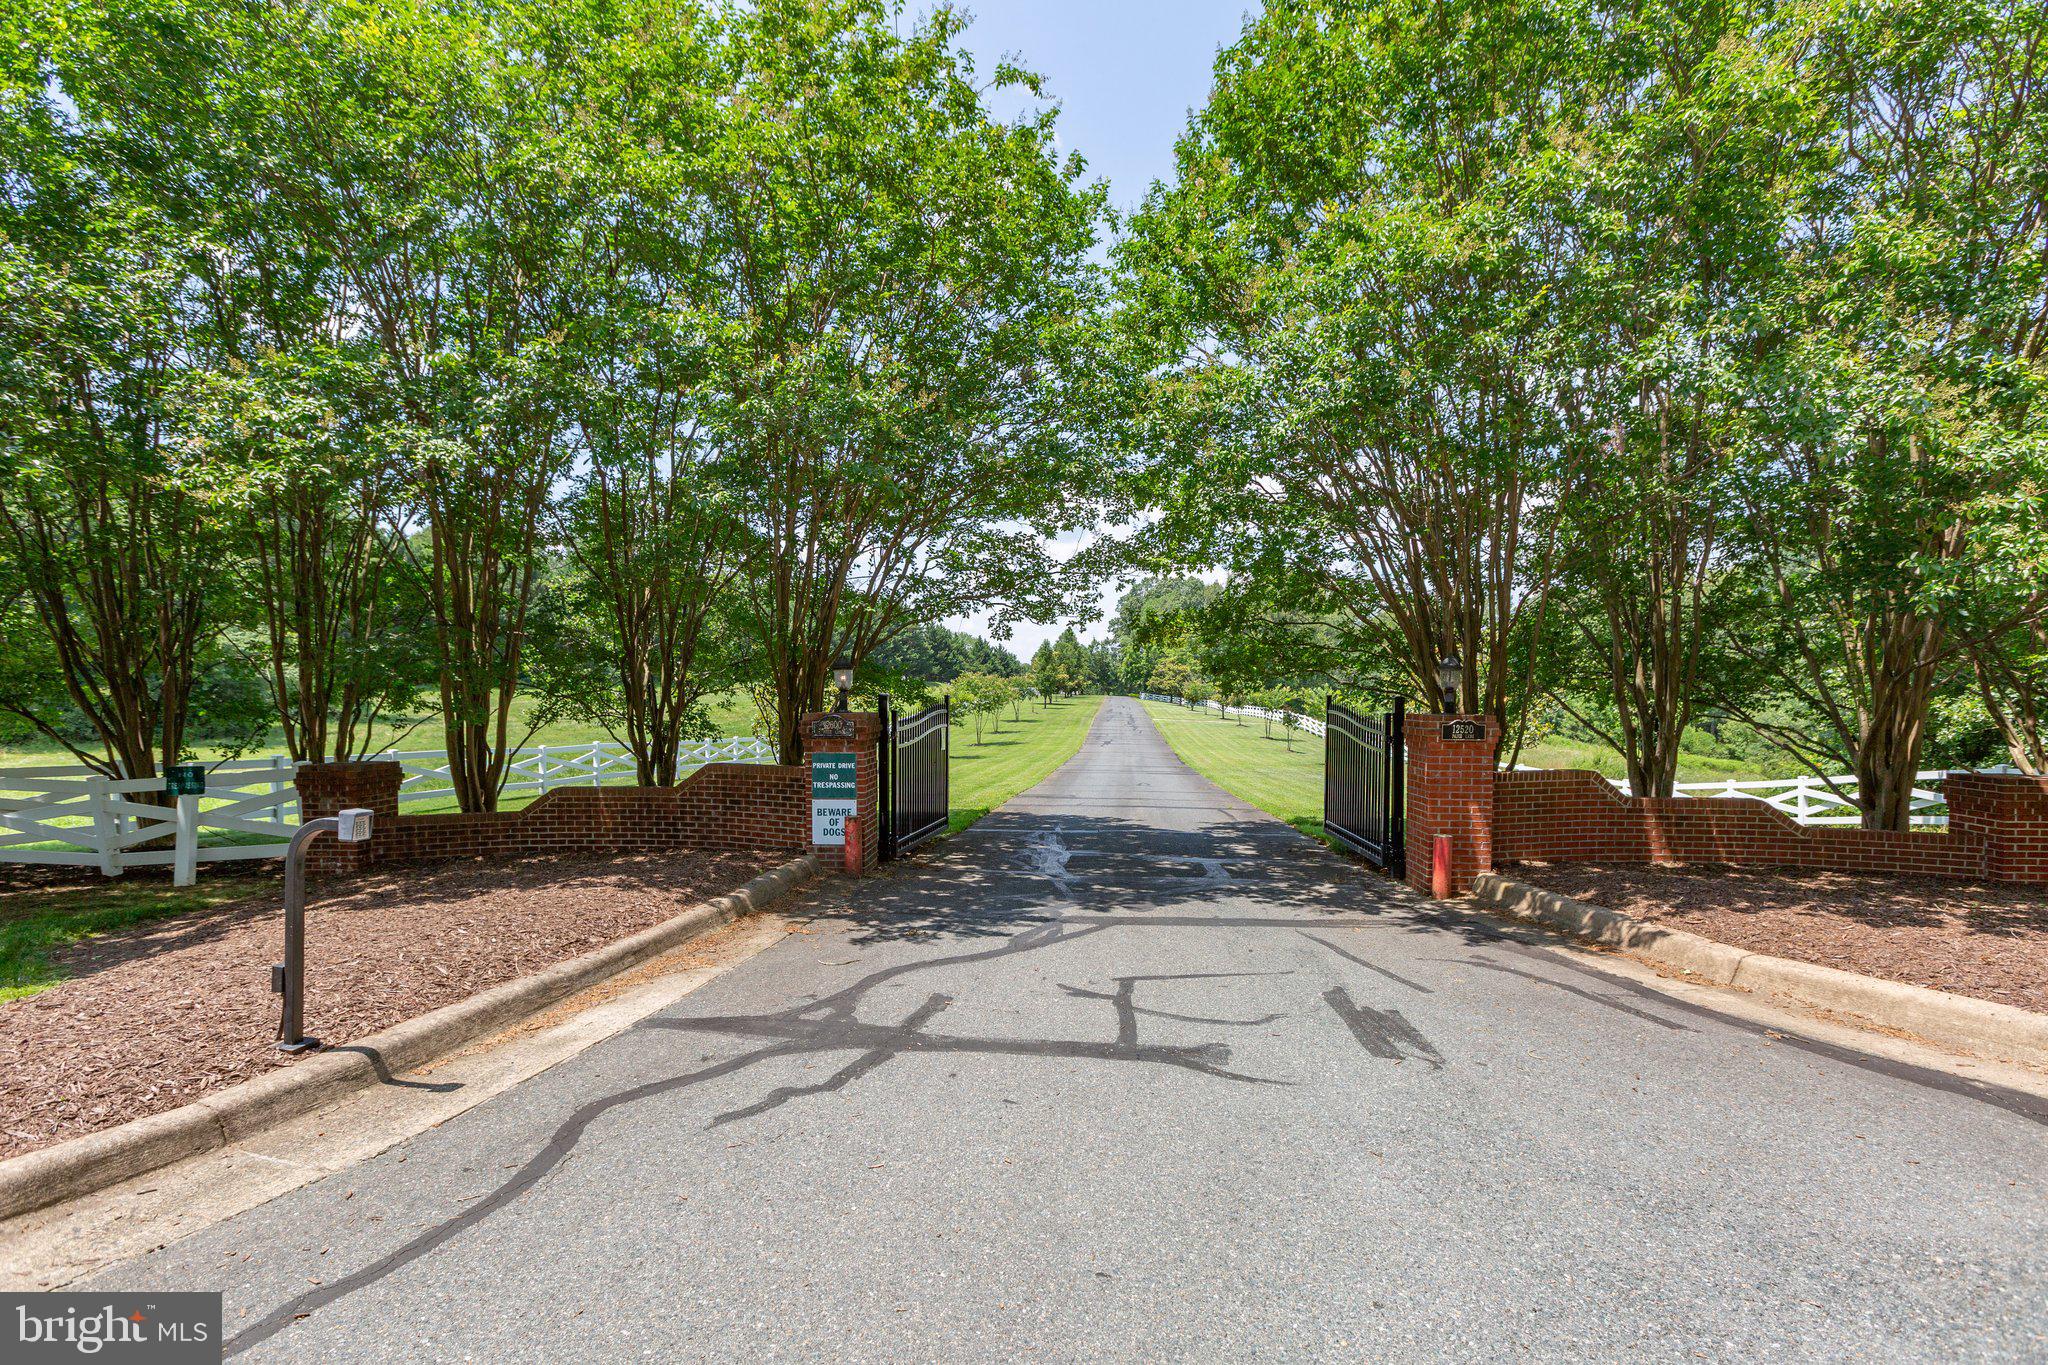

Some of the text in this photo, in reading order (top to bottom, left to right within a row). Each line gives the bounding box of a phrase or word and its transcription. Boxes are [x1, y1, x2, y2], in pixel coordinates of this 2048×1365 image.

[1452, 724, 1474, 733] 12520
[813, 781, 856, 789] TRESPASSING
[816, 808, 852, 817] BEWARE
[829, 818, 840, 827] OF
[823, 827, 846, 837] DOGS
